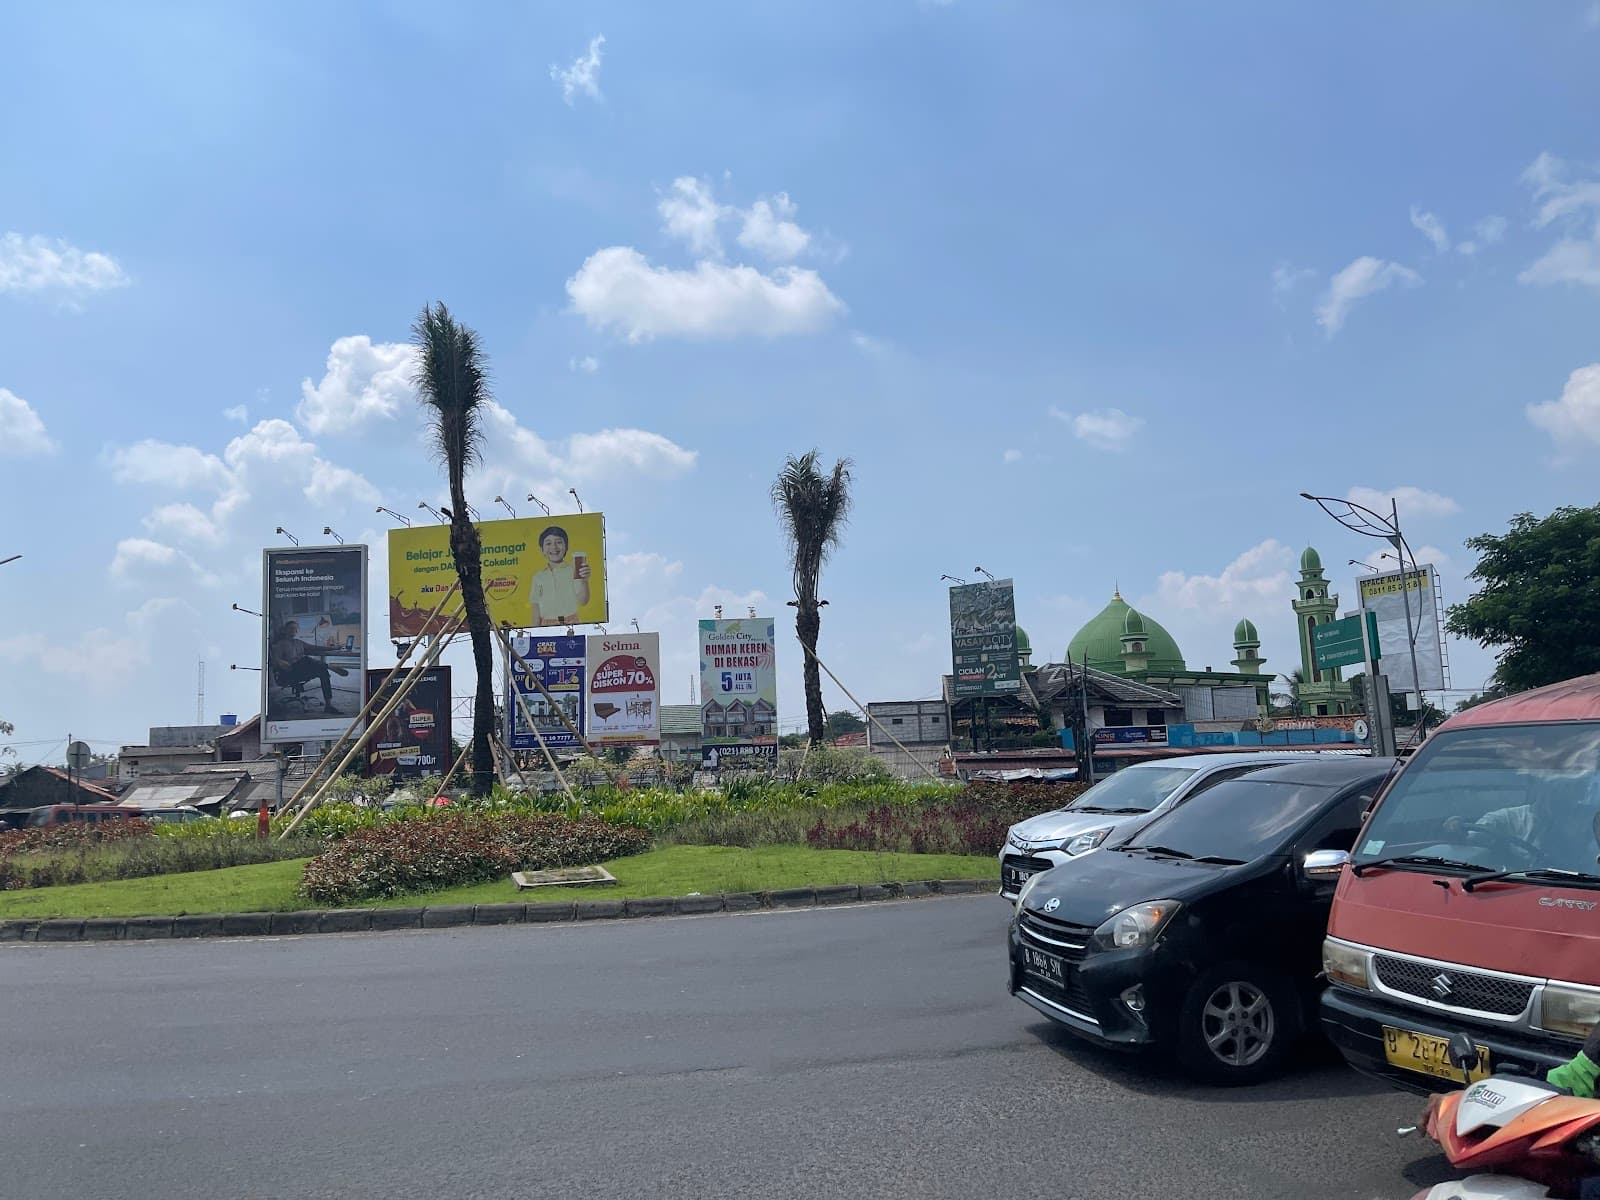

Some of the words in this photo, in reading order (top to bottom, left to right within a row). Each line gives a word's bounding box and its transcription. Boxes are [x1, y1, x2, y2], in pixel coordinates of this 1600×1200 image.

[406, 549, 443, 562] Belajar
[480, 542, 527, 555] emangat
[275, 569, 305, 577] Ekspansi
[305, 567, 315, 575] ke
[413, 565, 439, 573] dengan
[440, 562, 457, 571] DAN
[1362, 576, 1386, 588] SPACE
[1386, 569, 1428, 583] AVALABLE
[420, 585, 434, 593] aku
[708, 632, 735, 641] Golden
[736, 632, 753, 642] City
[991, 634, 1014, 645] CITY
[537, 646, 557, 654] DEAL
[602, 640, 641, 652] Selma
[705, 643, 737, 656] RUMAH
[740, 642, 768, 654] KEREN
[714, 657, 724, 668] DI
[726, 656, 759, 668] BEKASI
[596, 669, 624, 681] SUPER
[958, 667, 985, 675] CICILAN
[986, 663, 997, 680] 2
[593, 677, 627, 689] DISKON
[626, 671, 653, 686] 70%
[721, 671, 733, 692] 5
[735, 672, 752, 681] JUTA
[719, 747, 739, 757] (021)
[1538, 897, 1599, 911] CARRY
